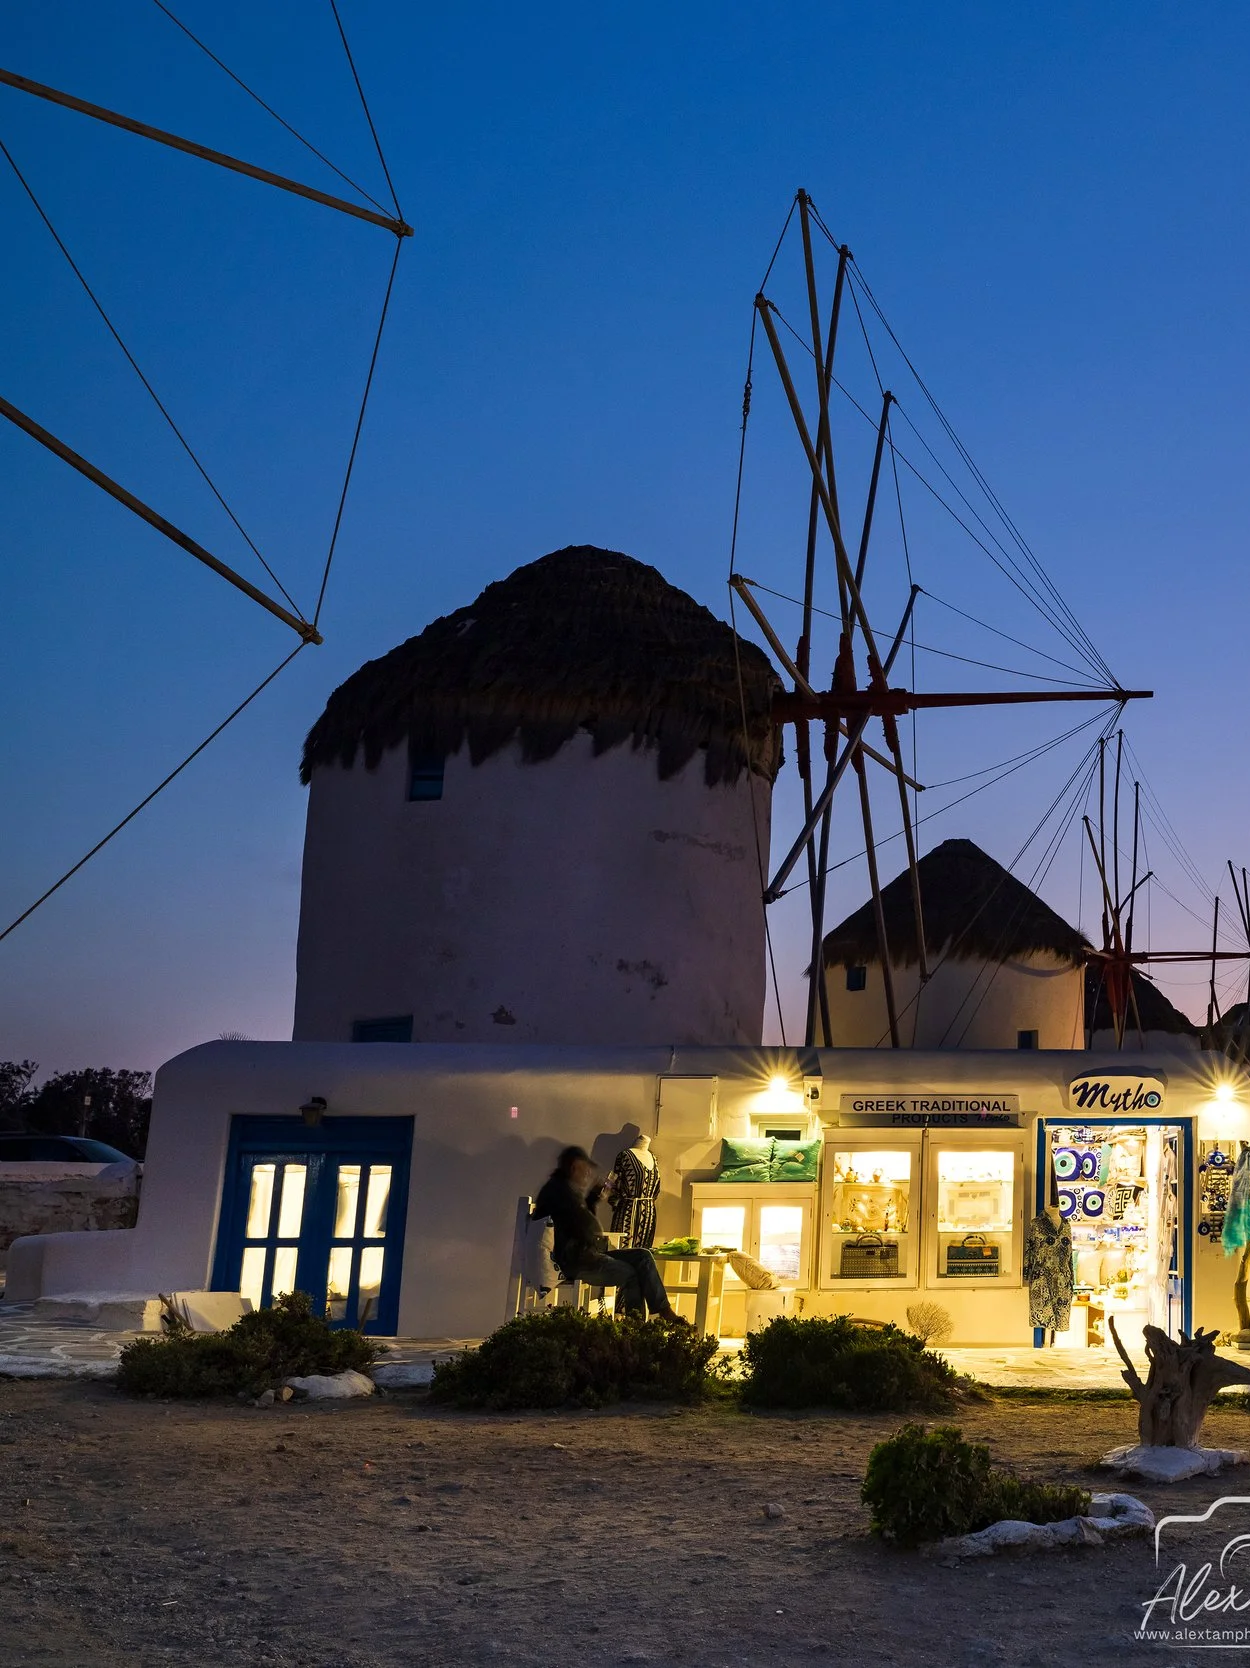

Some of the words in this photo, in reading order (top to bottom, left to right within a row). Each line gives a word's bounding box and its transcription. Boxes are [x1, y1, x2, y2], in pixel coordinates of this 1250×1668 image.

[1072, 1081, 1161, 1112] Mytho
[852, 1100, 906, 1112] GREEK
[911, 1100, 1011, 1112] TRADITIONAL
[892, 1113, 968, 1124] PRODUCTS
